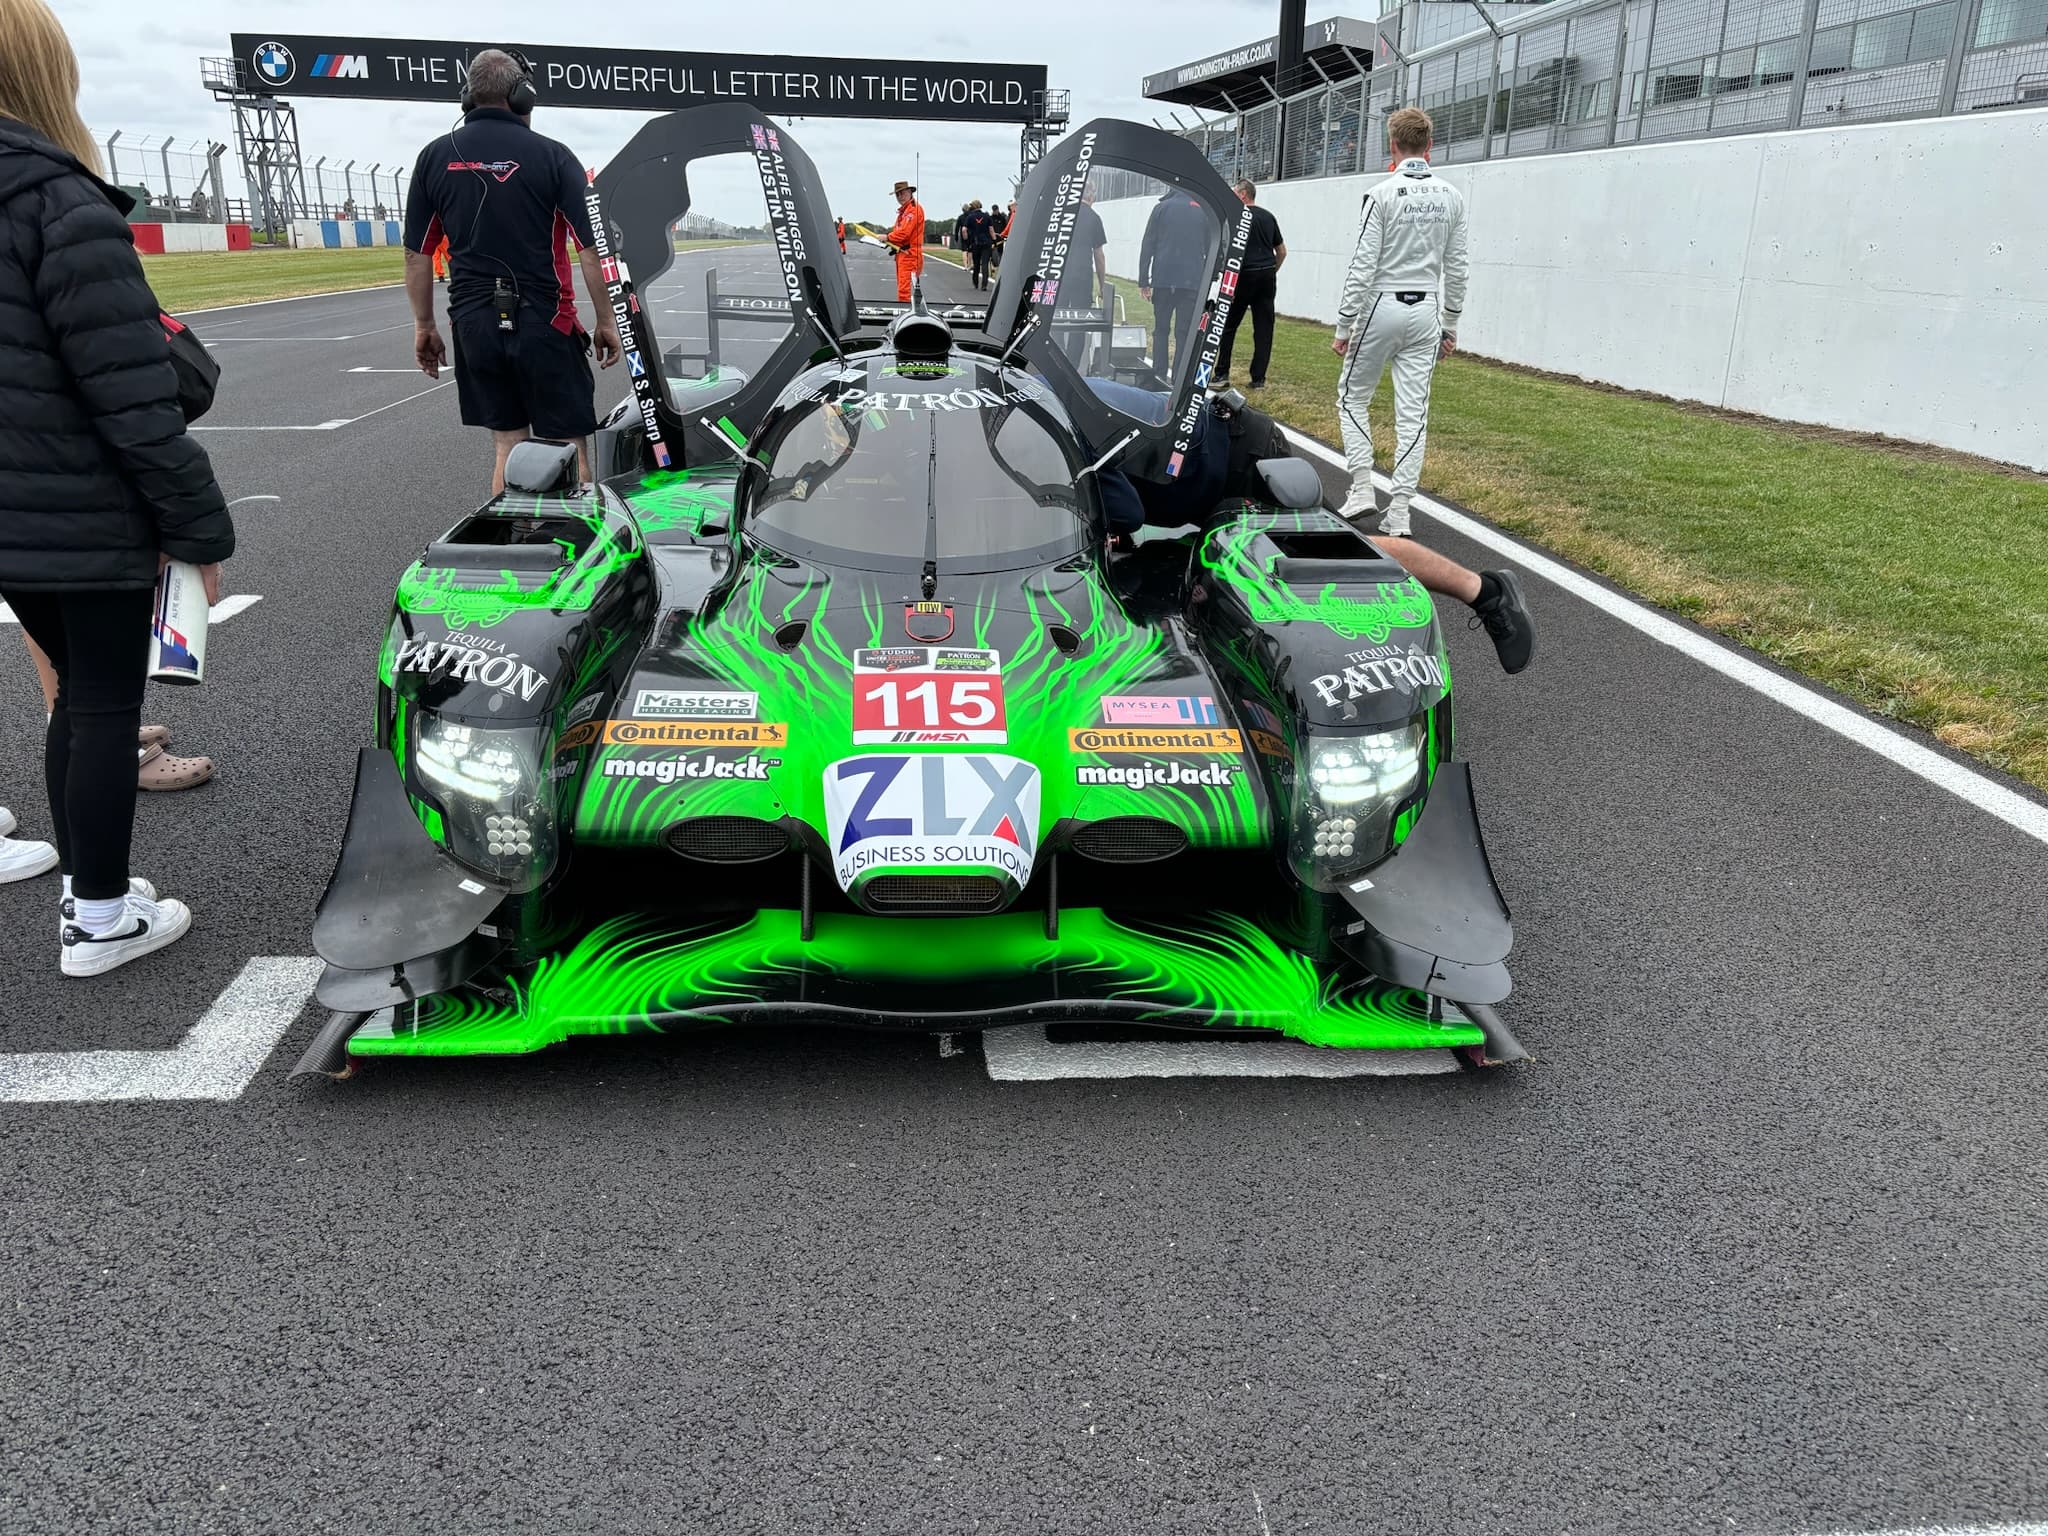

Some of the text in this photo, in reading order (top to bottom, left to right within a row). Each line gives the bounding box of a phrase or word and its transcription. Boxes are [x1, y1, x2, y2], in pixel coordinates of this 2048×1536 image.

[258, 44, 289, 57] BMW
[386, 56, 449, 83] THE
[547, 63, 706, 95] POWERFUL
[712, 70, 820, 98] LETTER
[829, 75, 857, 99] IN
[861, 76, 918, 102] THE
[925, 78, 1029, 105] WORLD.
[772, 151, 806, 260] ALFIE BRIGGS
[1049, 132, 1097, 280] JUSTIN WILSON
[1411, 186, 1449, 194] UBER
[585, 194, 609, 256] Hansson
[756, 151, 803, 302] JUSTIN WILSON
[1036, 174, 1072, 279] ALFIE BRIGGS
[1227, 256, 1243, 270] D.
[608, 284, 637, 351] R. Dalziel
[1202, 297, 1232, 363] R. Dalziel
[634, 379, 661, 442] S. Sharp
[1174, 393, 1205, 451] S. Sharp
[445, 631, 506, 653] TEQUILA
[1344, 644, 1404, 663] TEQUILA
[643, 694, 750, 708] Masters
[866, 681, 996, 727] 115
[610, 723, 759, 743] Continental
[916, 733, 970, 742] IMSA
[1074, 731, 1214, 750] Continental
[837, 756, 1036, 858] ZLX
[840, 846, 926, 886] BUSINESS
